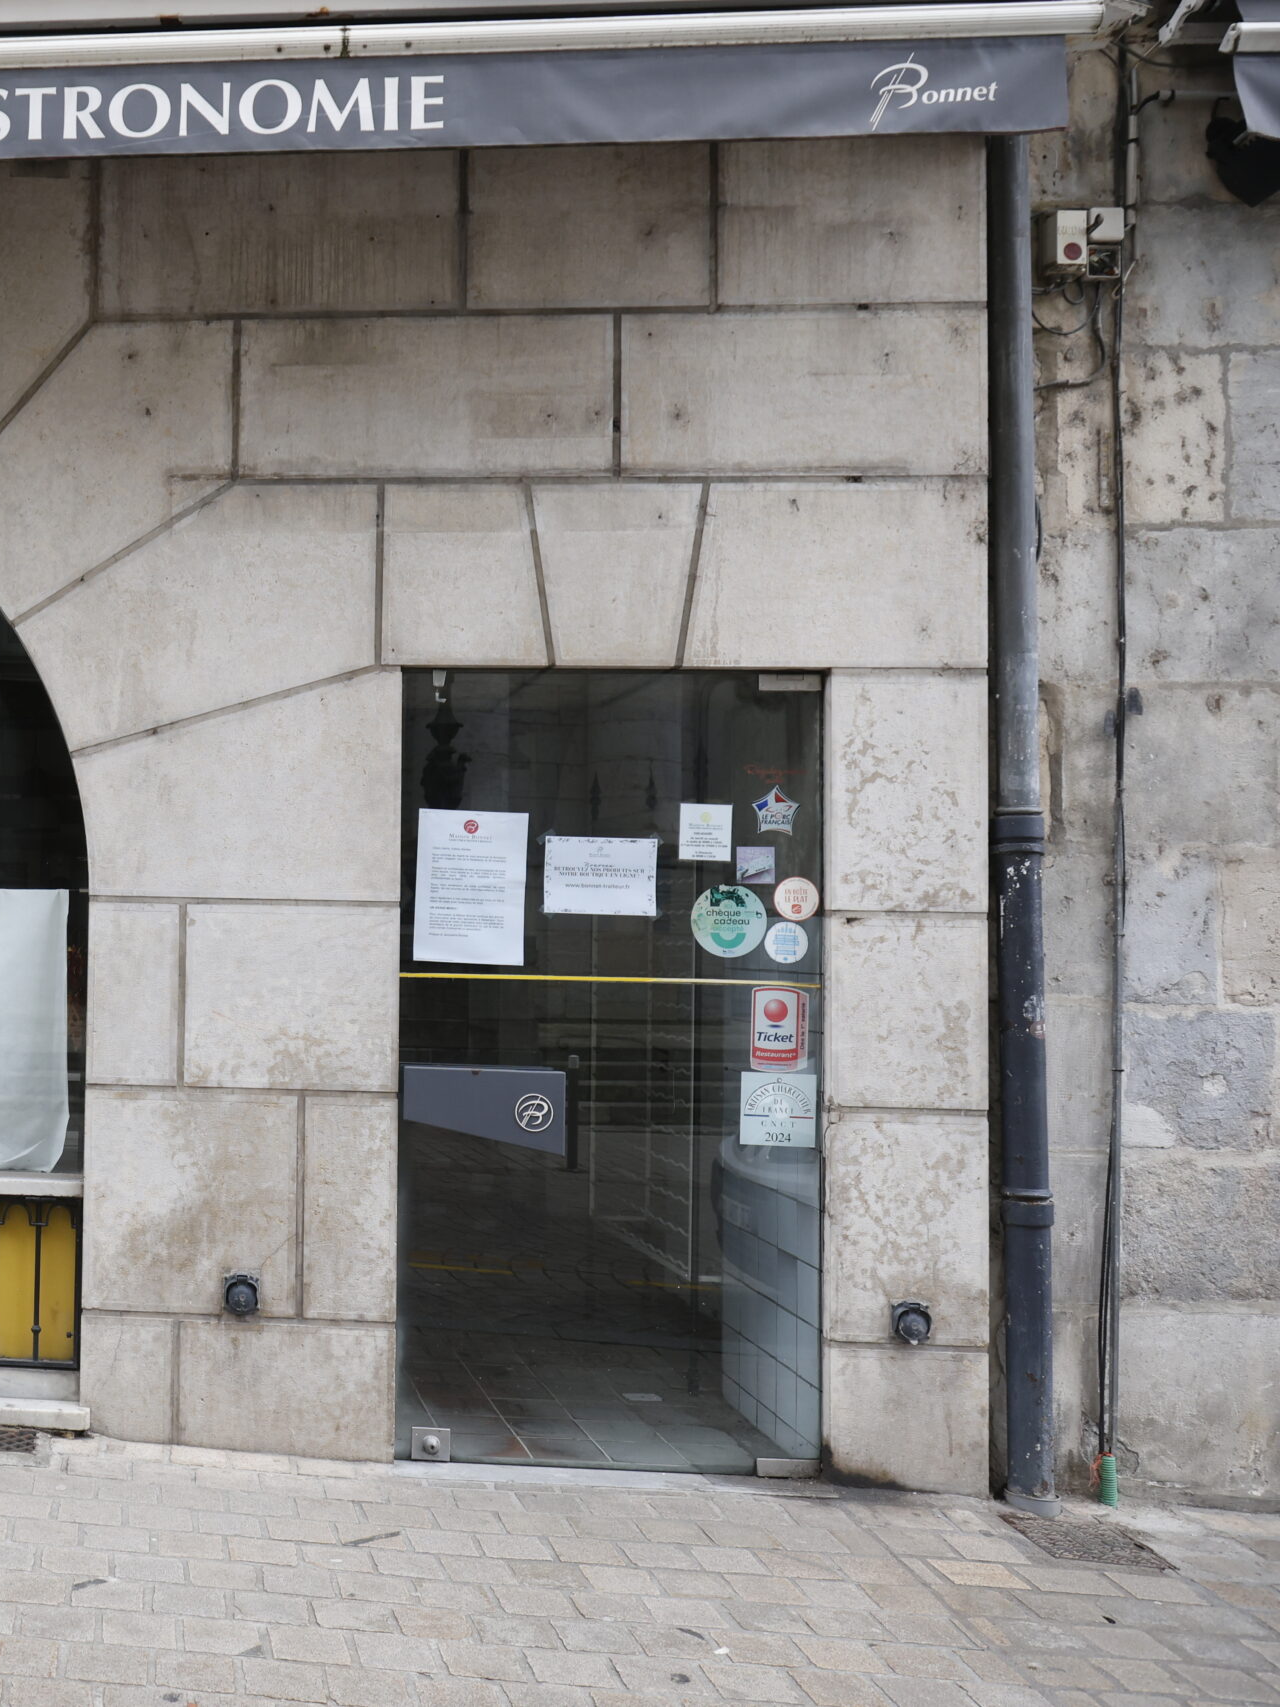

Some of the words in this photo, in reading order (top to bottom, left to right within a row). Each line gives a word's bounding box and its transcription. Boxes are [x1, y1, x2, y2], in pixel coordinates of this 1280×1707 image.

[870, 52, 998, 131] Bonnet
[706, 909, 741, 918] chèque
[756, 1031, 795, 1043] Ticket
[764, 1132, 792, 1143] 2024
